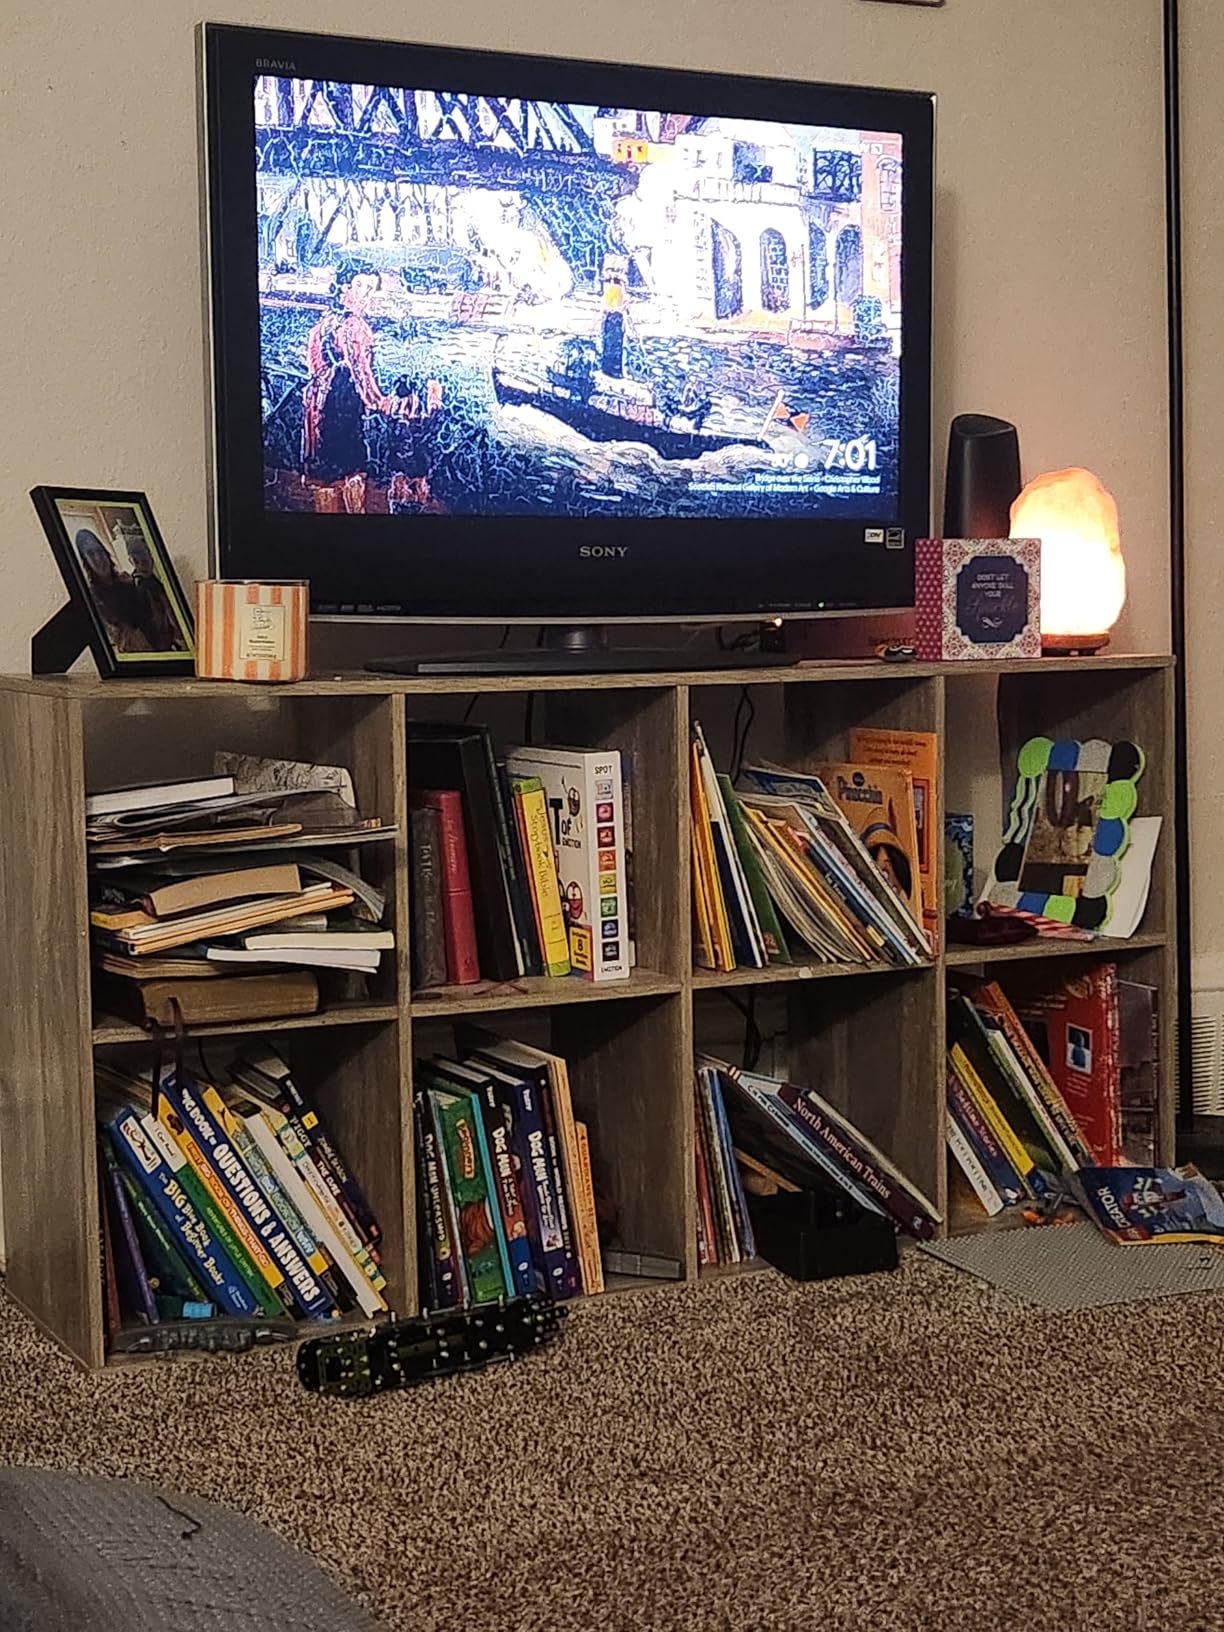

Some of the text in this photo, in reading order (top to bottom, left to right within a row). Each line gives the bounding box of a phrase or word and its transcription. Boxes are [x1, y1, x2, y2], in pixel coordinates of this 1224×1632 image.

[256, 58, 296, 71] BRAVIA
[822, 439, 877, 471] 7:01
[580, 545, 629, 558] SONY
[595, 765, 613, 774] SPOT
[528, 814, 546, 869] Storybook
[539, 870, 550, 898] Bible
[577, 938, 584, 951] 8
[600, 965, 623, 973] EMOTION
[189, 1107, 213, 1139] BOOK
[288, 1115, 312, 1149] PIGGY
[315, 1159, 329, 1176] THE
[490, 1126, 513, 1178] DOG MAN
[527, 1130, 548, 1181] DOG MAN
[792, 1097, 893, 1199] North American Trains
[976, 1125, 1000, 1158] Stories
[423, 1133, 447, 1241] DOG MAN UNLEASHED
[552, 1166, 563, 1194] WORLD
[161, 1179, 188, 1211] BIG
[180, 1204, 198, 1224] Blue
[192, 1221, 213, 1246] Book
[211, 1142, 320, 1303] QUESTIONS & ANSWERS
[556, 1194, 568, 1230] RECORDS
[1097, 1186, 1131, 1228] CREATOR
[179, 1221, 208, 1260] Beginner
[202, 1256, 226, 1286] Books
[246, 1233, 262, 1254] THAT
